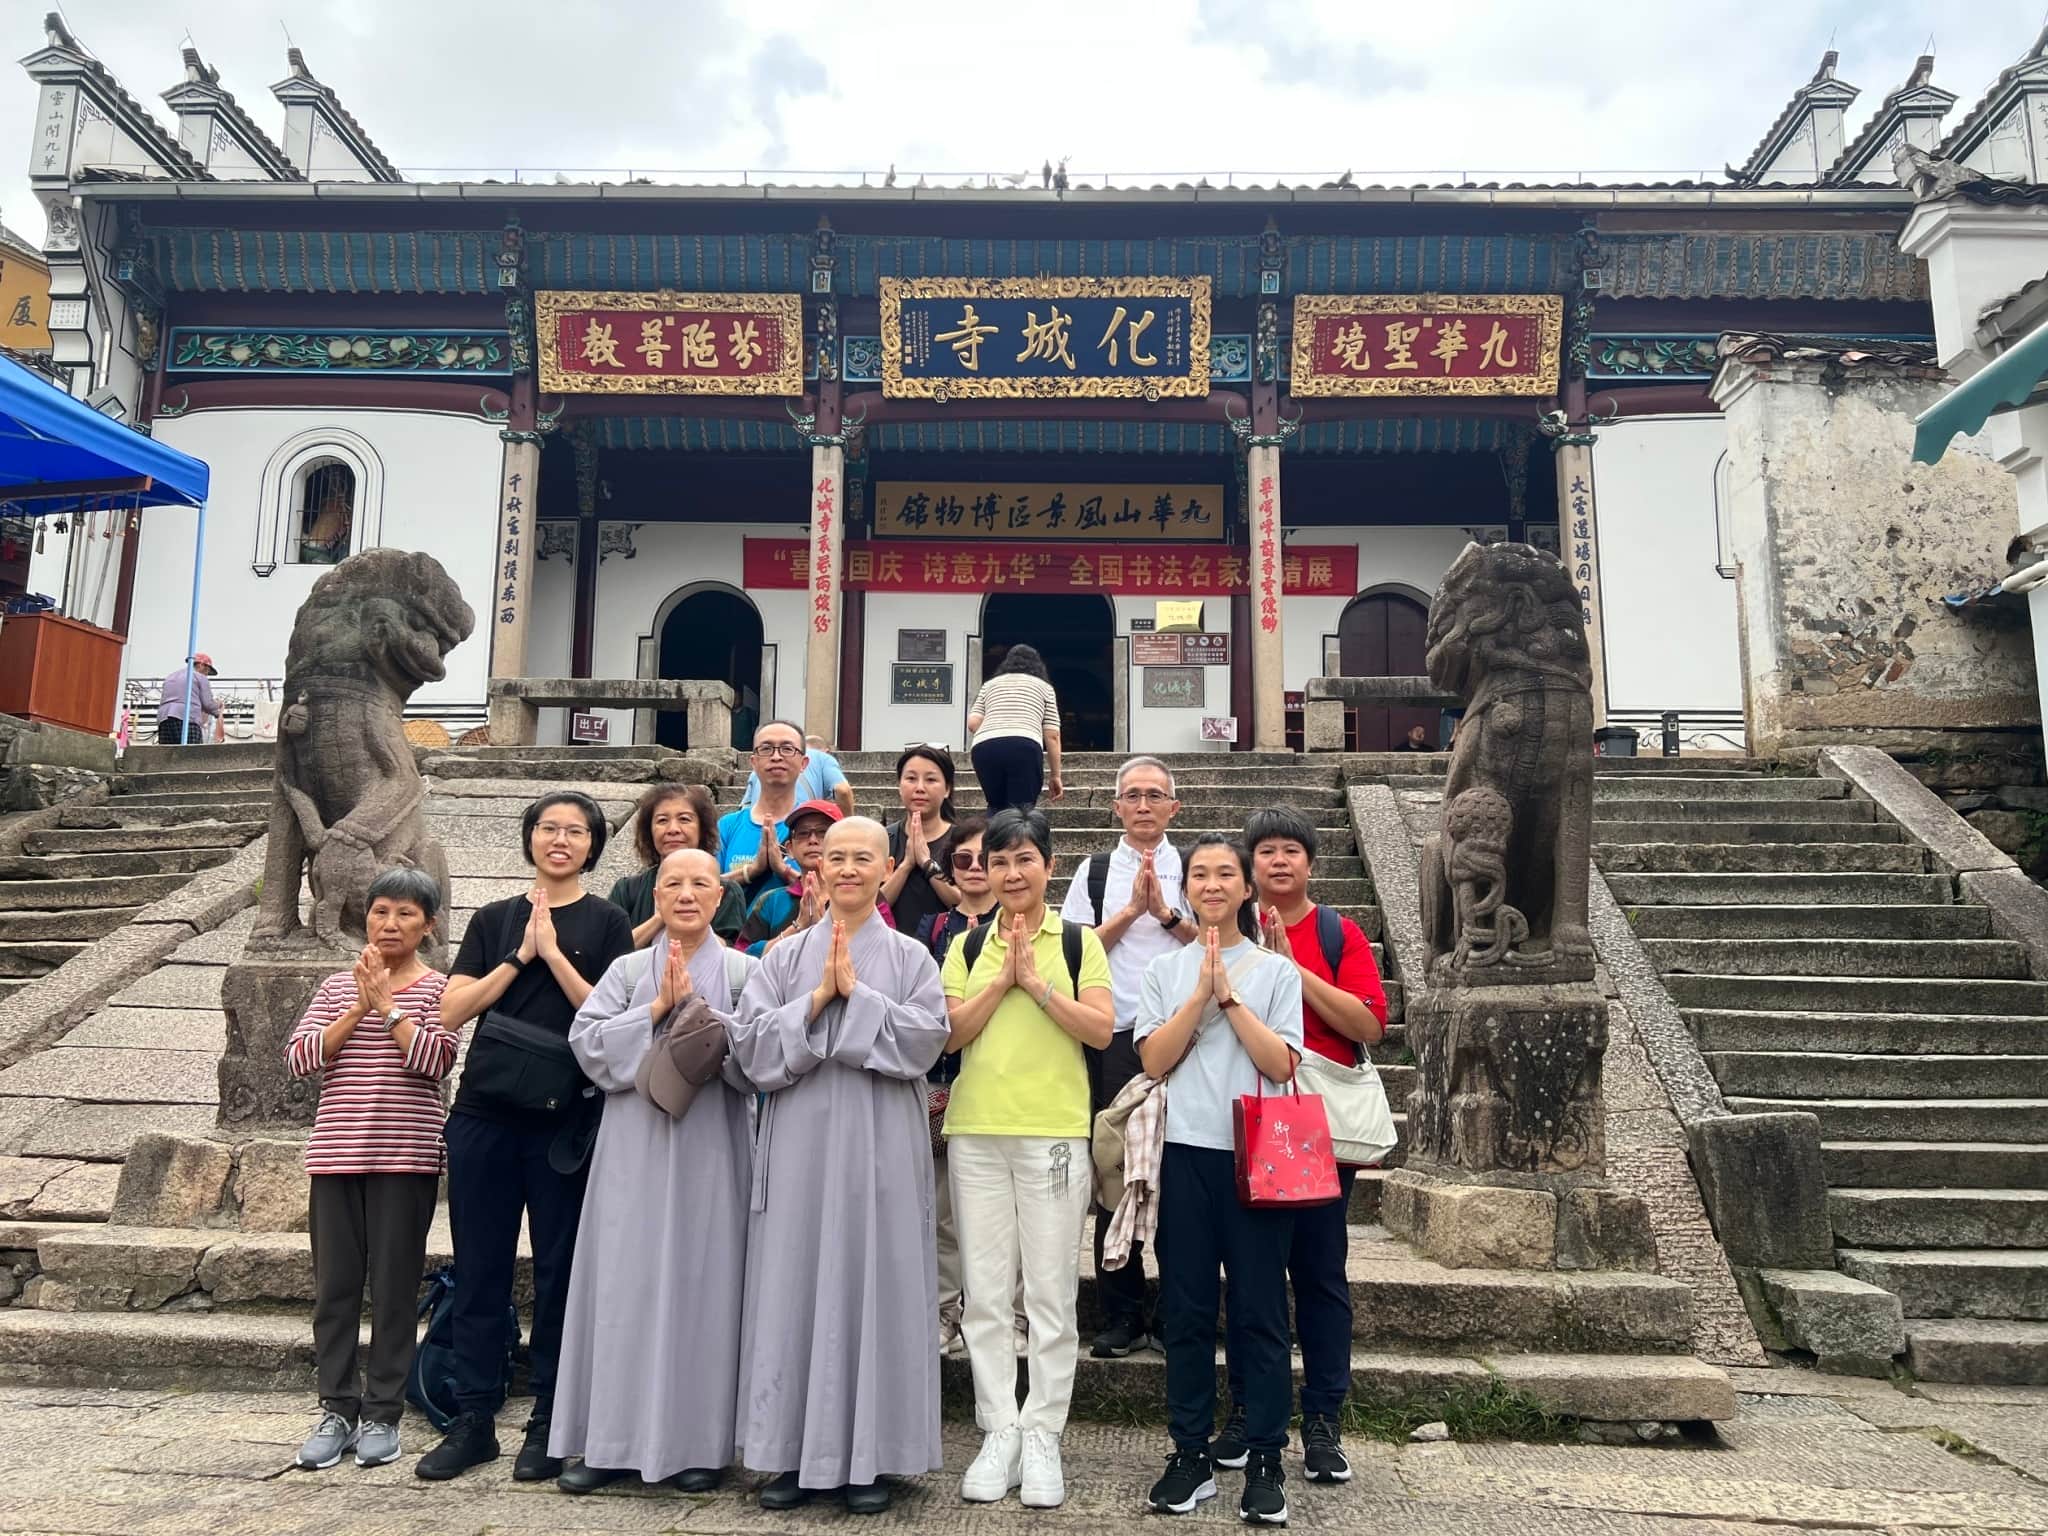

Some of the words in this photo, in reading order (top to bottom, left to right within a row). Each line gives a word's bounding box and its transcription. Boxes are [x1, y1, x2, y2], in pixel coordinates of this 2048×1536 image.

[934, 304, 1158, 371] 化城寺
[1331, 319, 1518, 374] 九華聖境
[773, 550, 904, 583] “喜国庆
[1069, 554, 1333, 588] 全国书法名家请展
[580, 718, 603, 730] 出口
